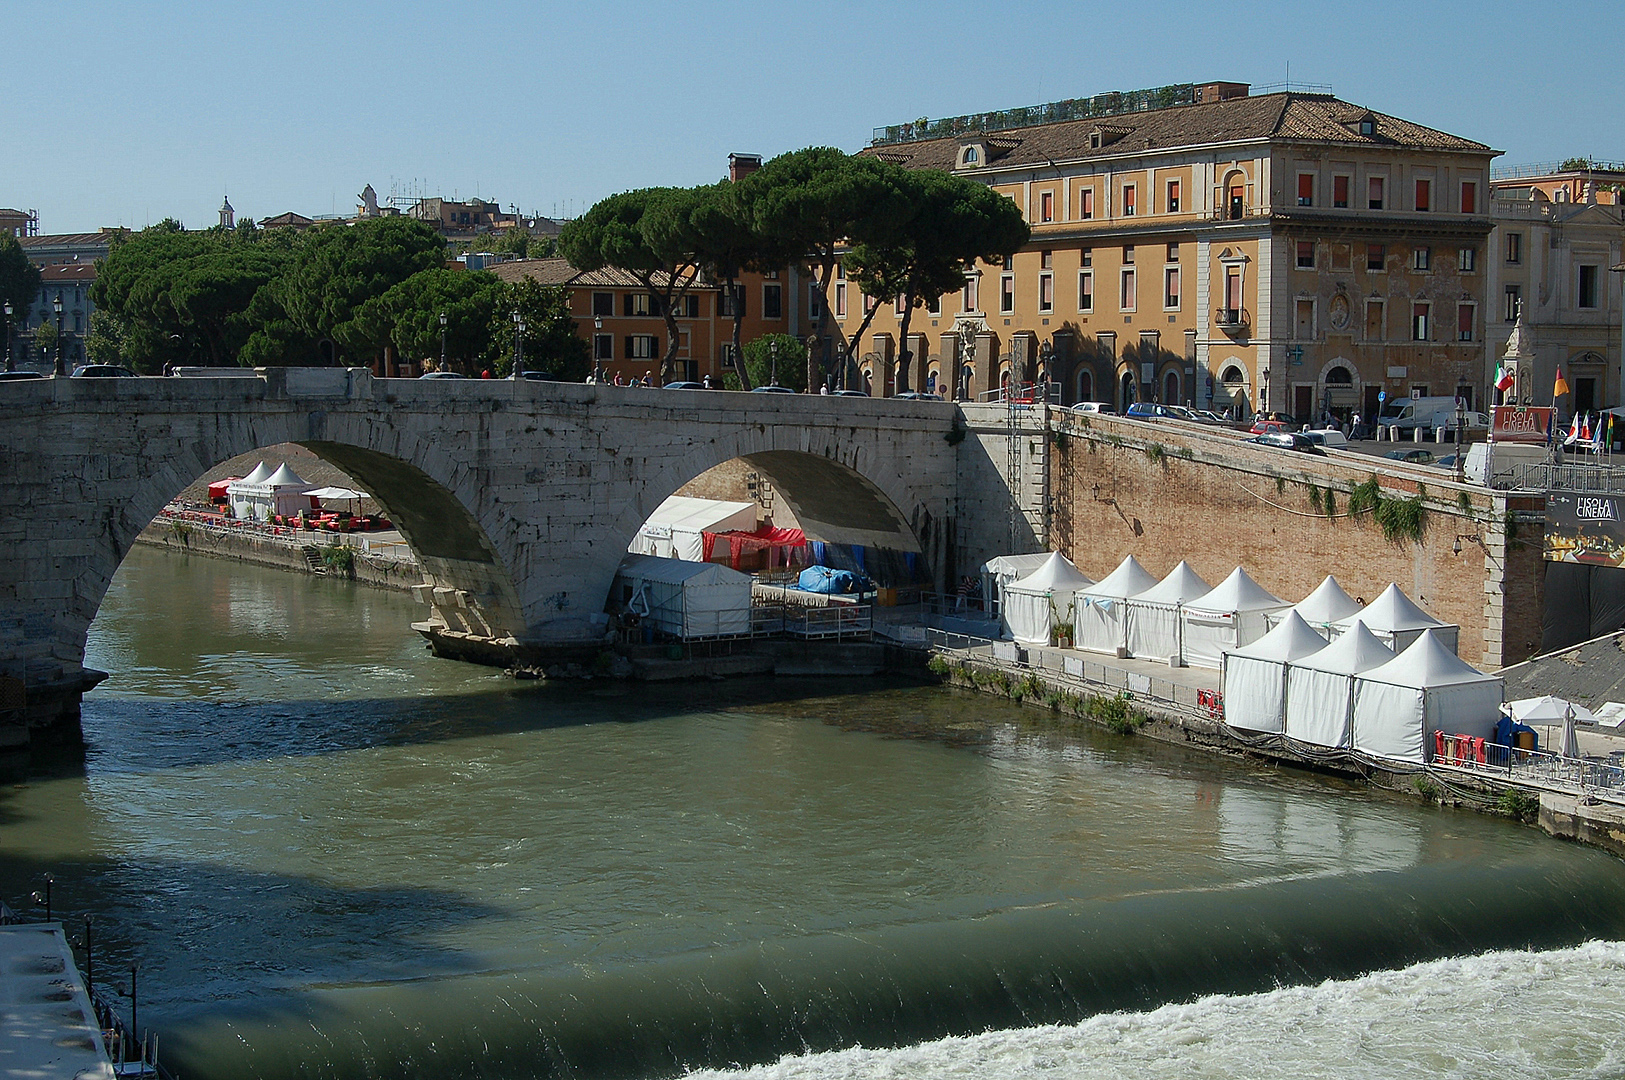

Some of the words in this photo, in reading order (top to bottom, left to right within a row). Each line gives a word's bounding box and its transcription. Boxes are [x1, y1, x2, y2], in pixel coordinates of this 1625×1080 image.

[1503, 411, 1534, 423] L'ISOLA
[1502, 420, 1536, 432] CINEMA
[1577, 497, 1609, 509] L'ISOLA
[1576, 506, 1612, 518] CINEMA
